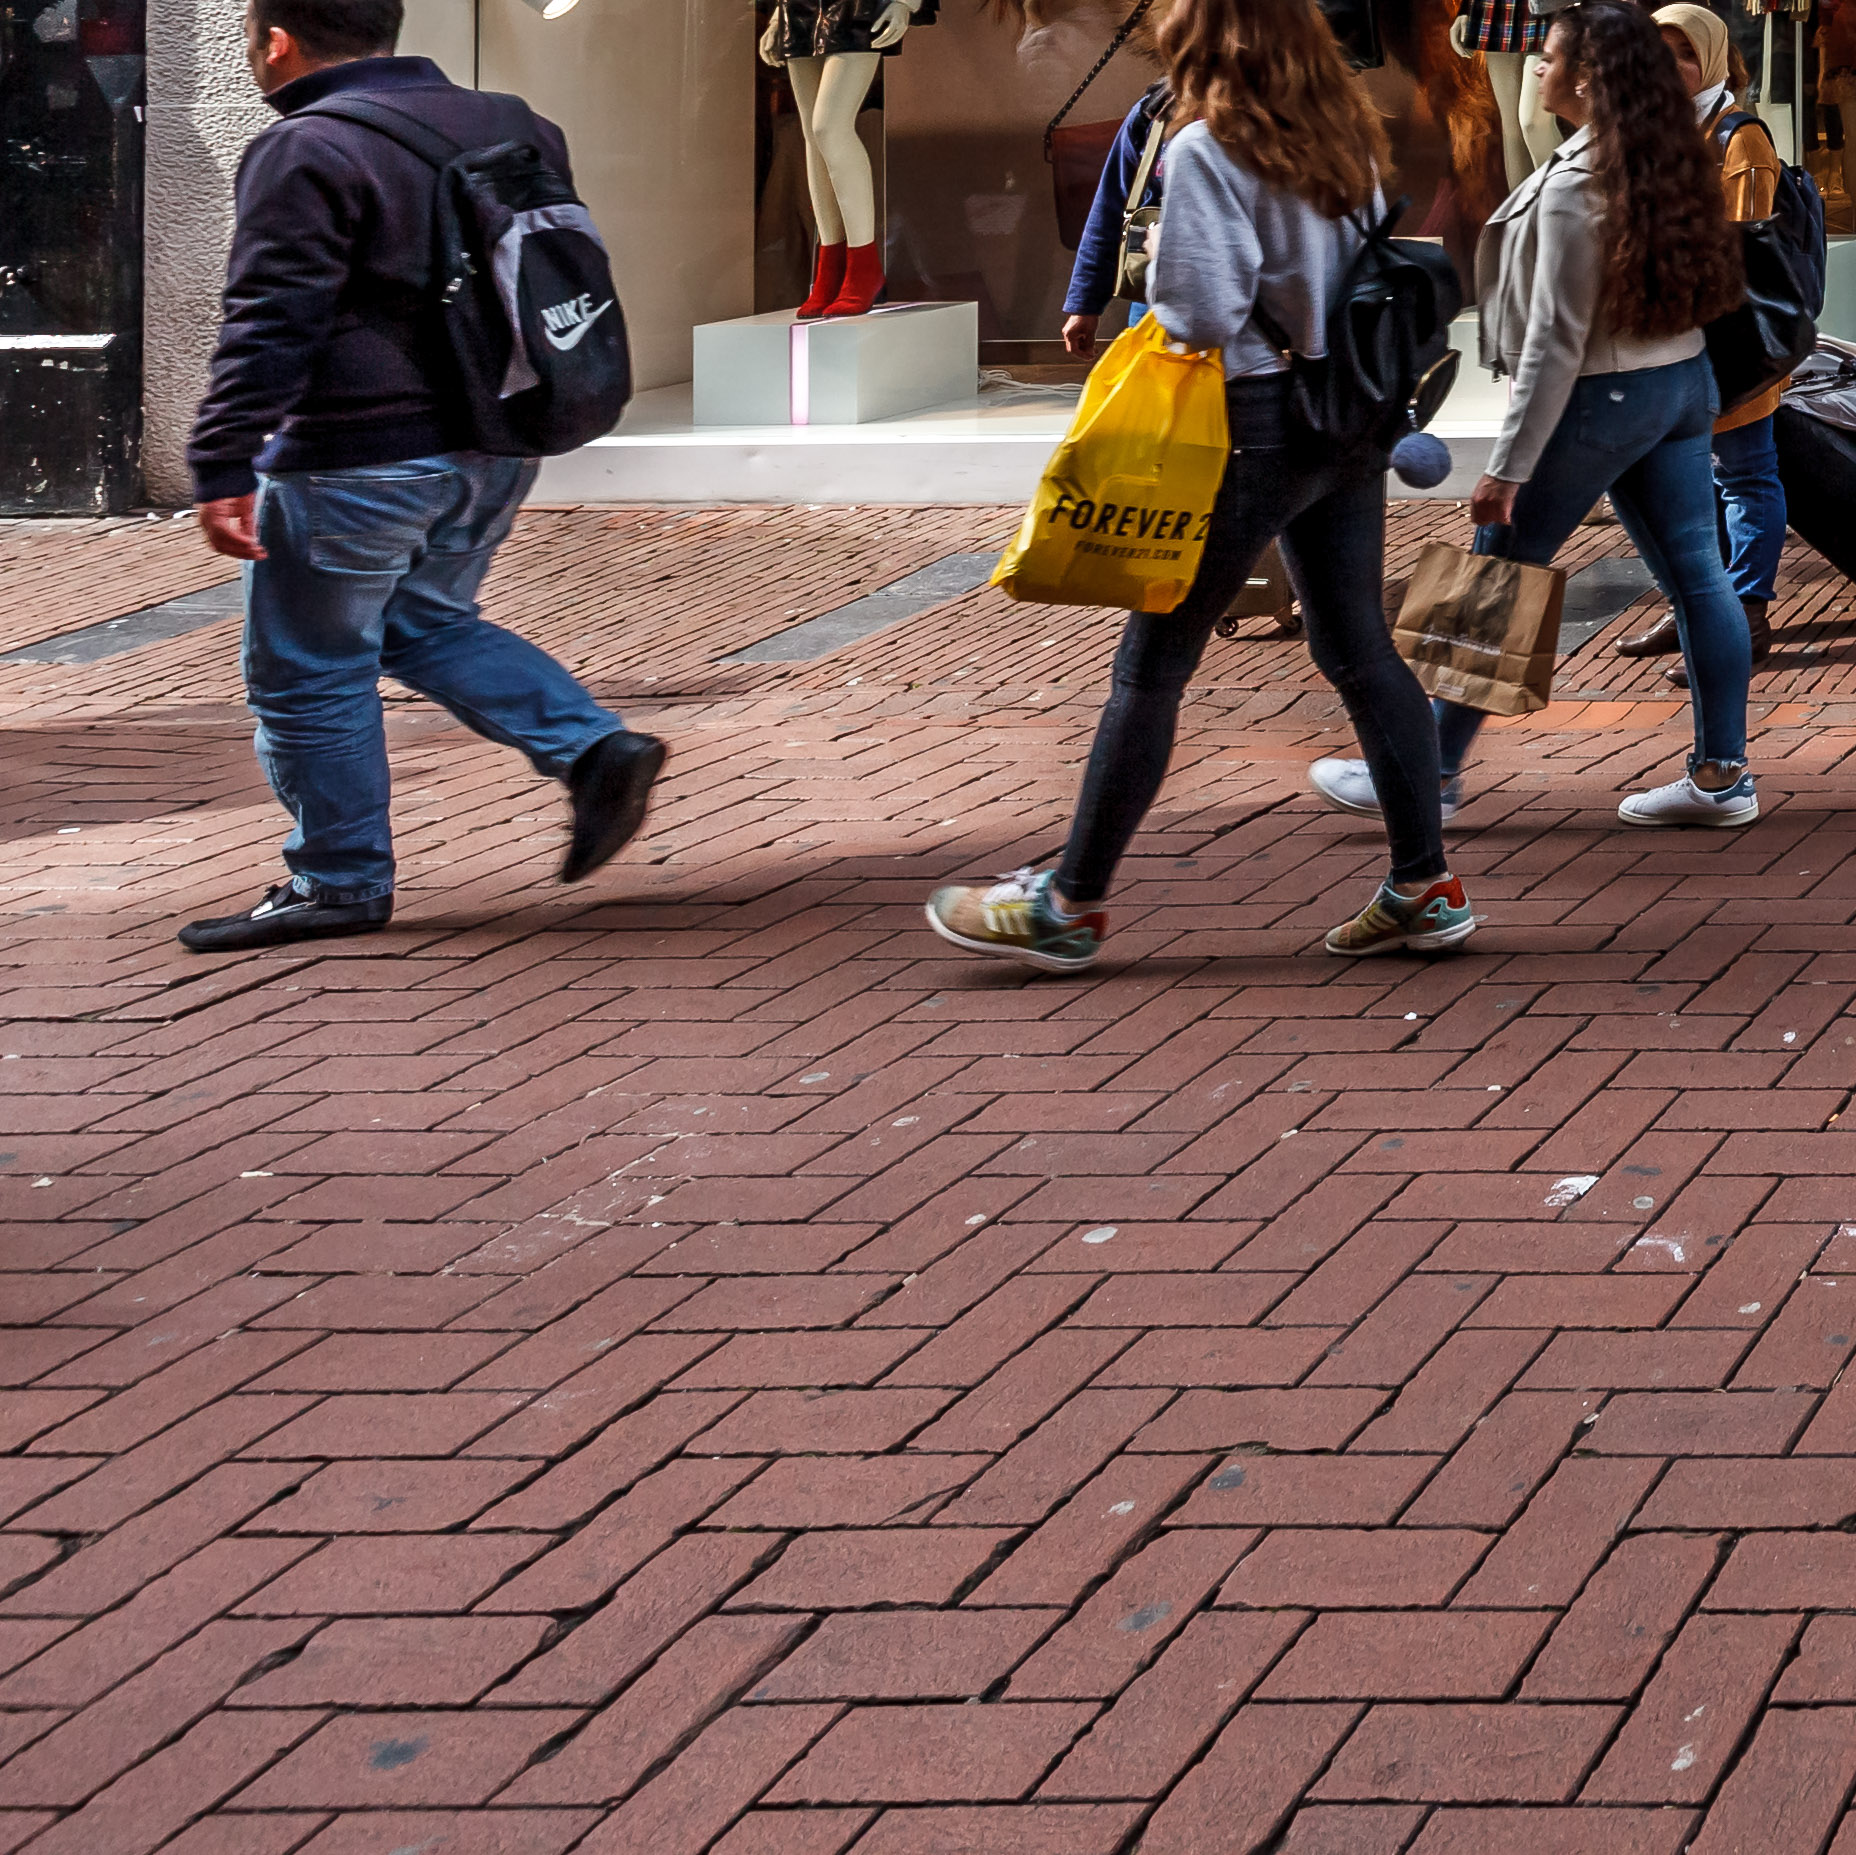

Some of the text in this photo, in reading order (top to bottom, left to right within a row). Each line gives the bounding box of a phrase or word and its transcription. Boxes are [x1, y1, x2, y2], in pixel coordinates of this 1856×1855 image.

[540, 292, 593, 331] NIKE
[1048, 494, 1213, 542] FOREVER 2
